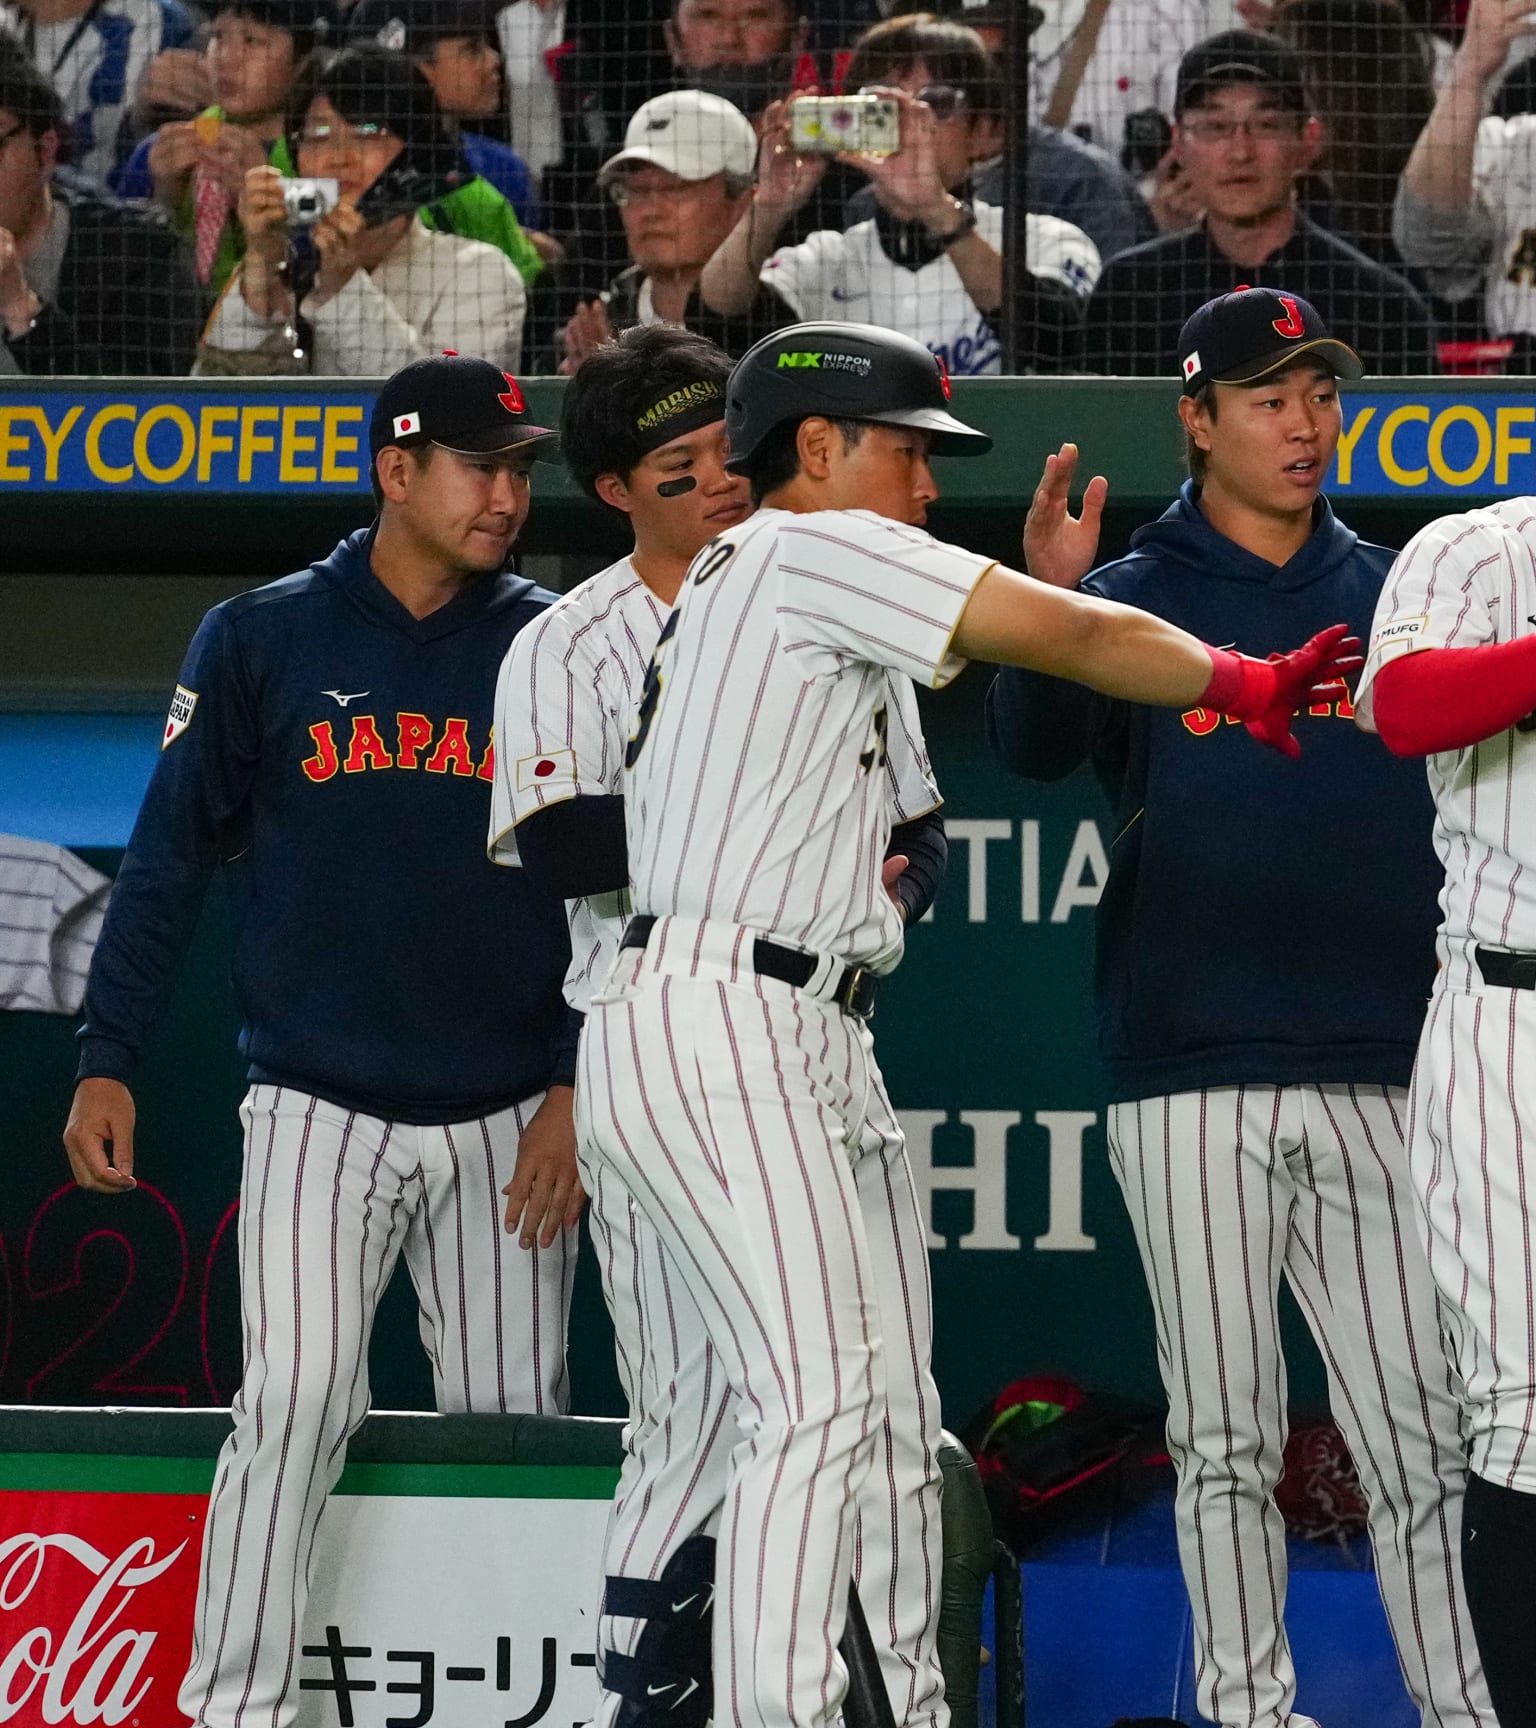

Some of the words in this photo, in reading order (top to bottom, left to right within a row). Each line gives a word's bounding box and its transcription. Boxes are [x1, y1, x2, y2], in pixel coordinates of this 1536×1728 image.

[1272, 297, 1305, 339] J
[823, 353, 872, 367] NIPPON
[497, 371, 526, 414] J
[1381, 623, 1419, 638] MUFG
[299, 1625, 600, 1728] キョーリ
